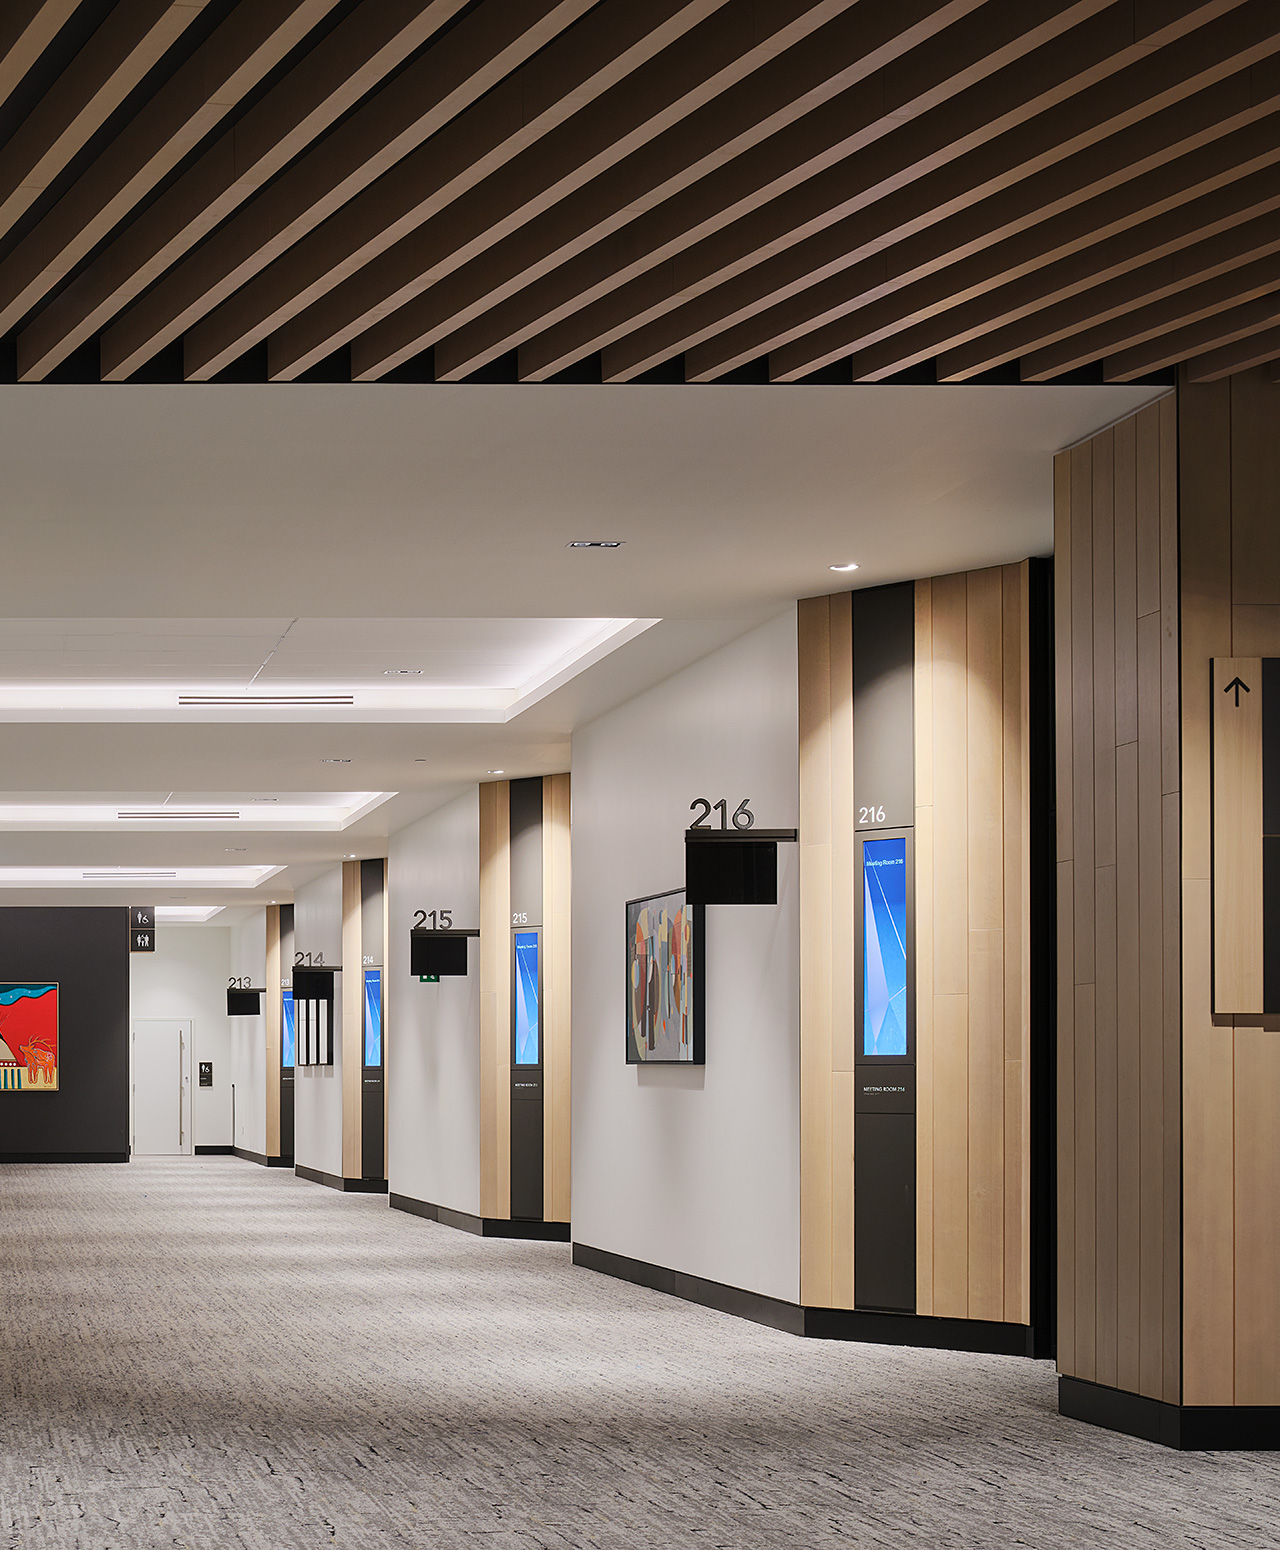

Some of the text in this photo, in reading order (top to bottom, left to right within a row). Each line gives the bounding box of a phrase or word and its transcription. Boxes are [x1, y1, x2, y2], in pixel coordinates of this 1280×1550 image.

[690, 798, 753, 830] 216
[858, 805, 885, 823] 216
[413, 909, 452, 930] 215
[512, 912, 528, 924] 215
[294, 951, 325, 967] 214
[362, 955, 374, 965] 214
[228, 976, 251, 989] 213
[280, 978, 290, 986] 213
